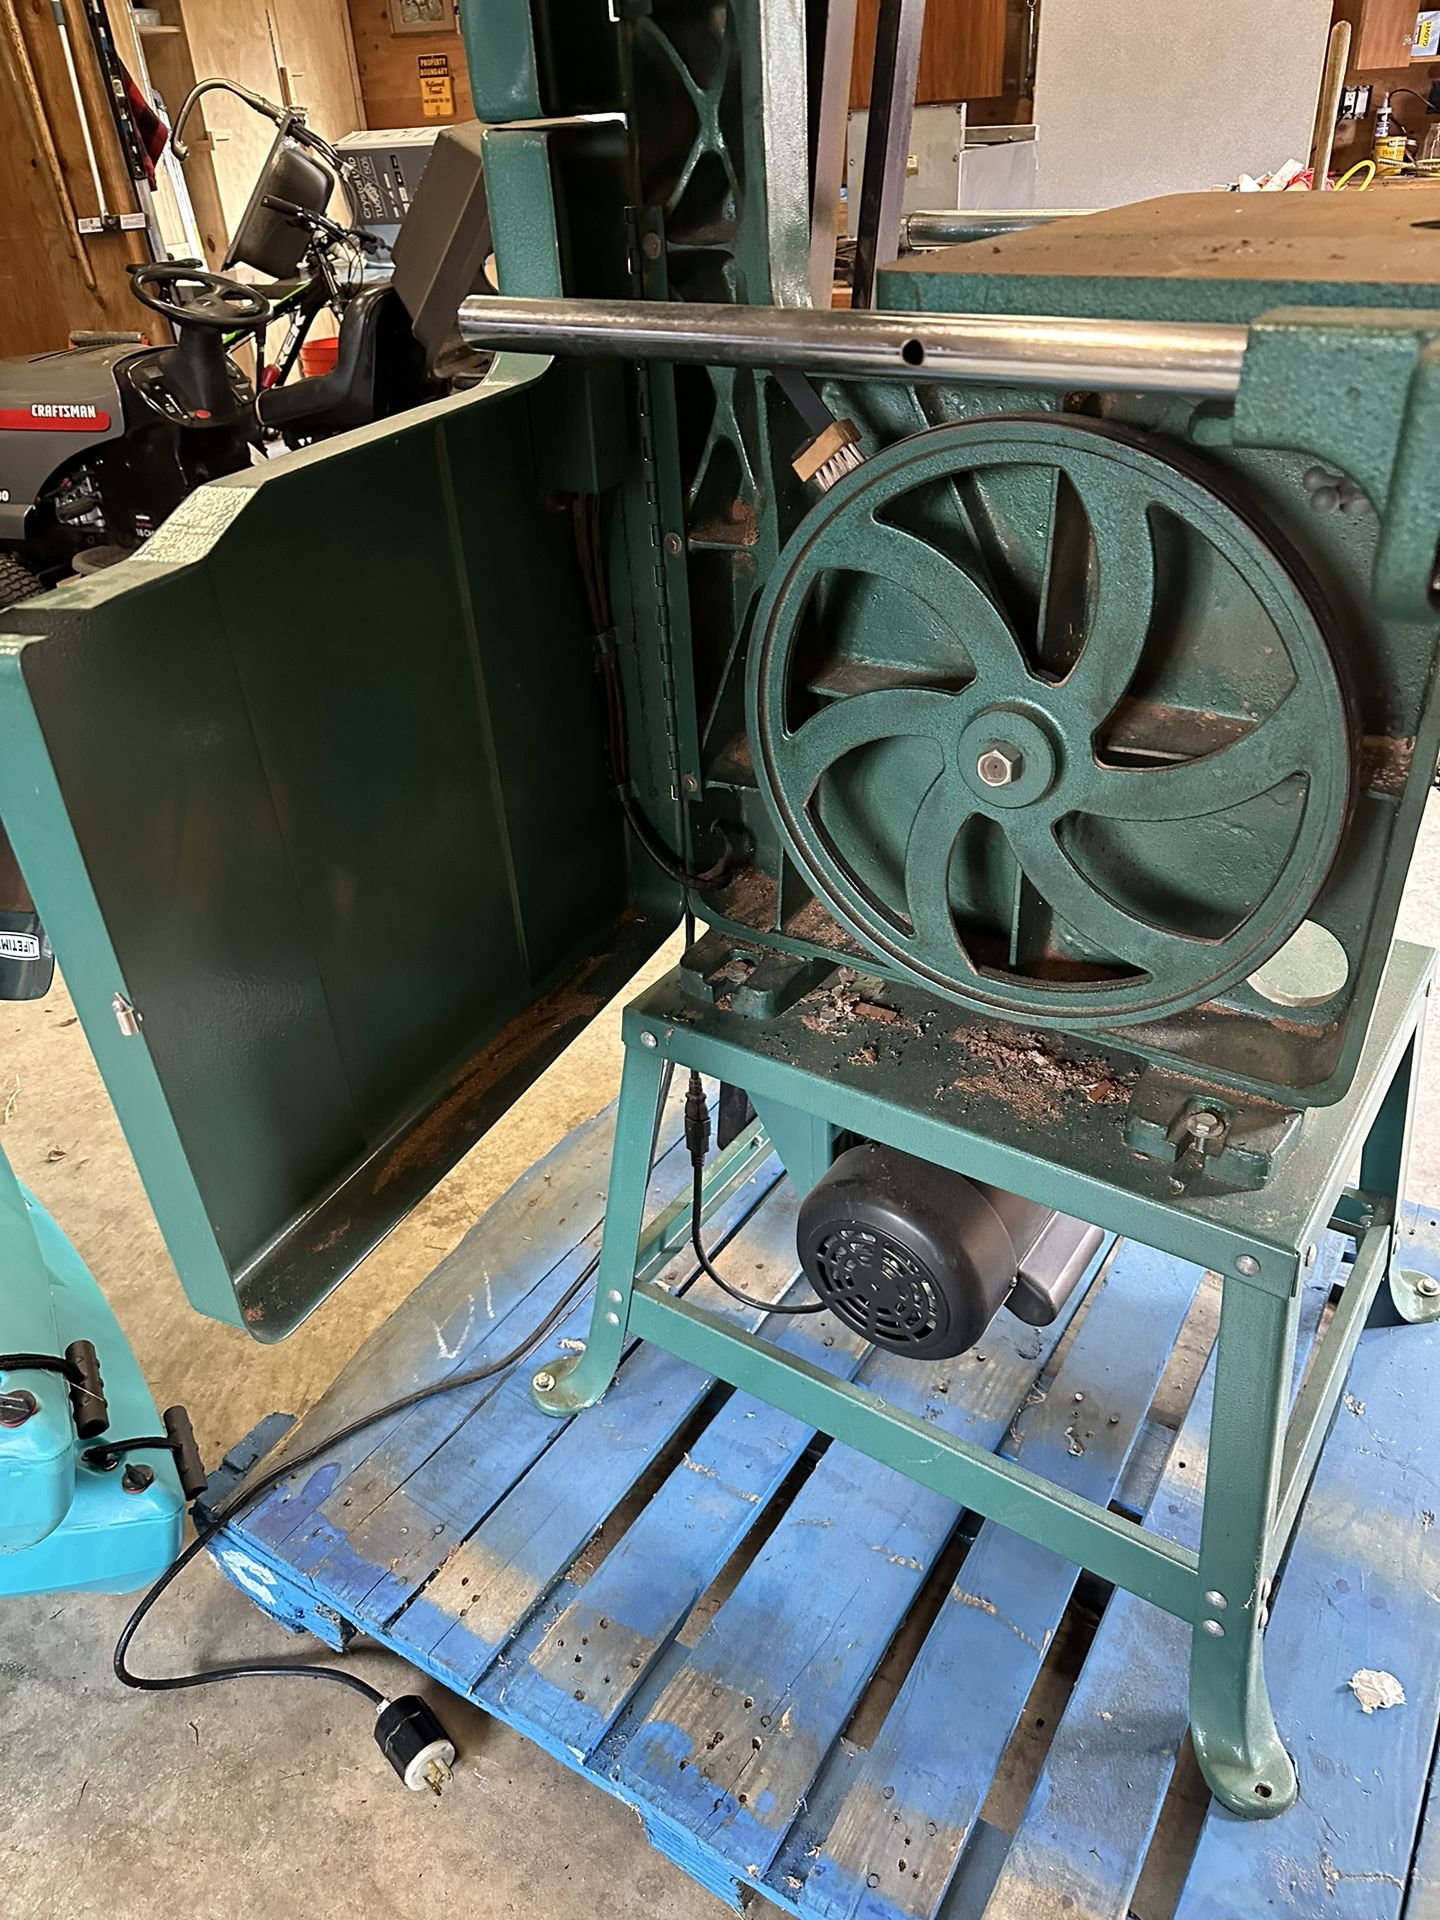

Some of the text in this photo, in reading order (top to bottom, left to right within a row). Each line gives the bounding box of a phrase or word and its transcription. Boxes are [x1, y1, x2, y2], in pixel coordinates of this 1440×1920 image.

[420, 58, 446, 67] PROPERTY
[31, 404, 96, 418] CRAFTSMAN
[0, 938, 35, 953] LIFETIM
